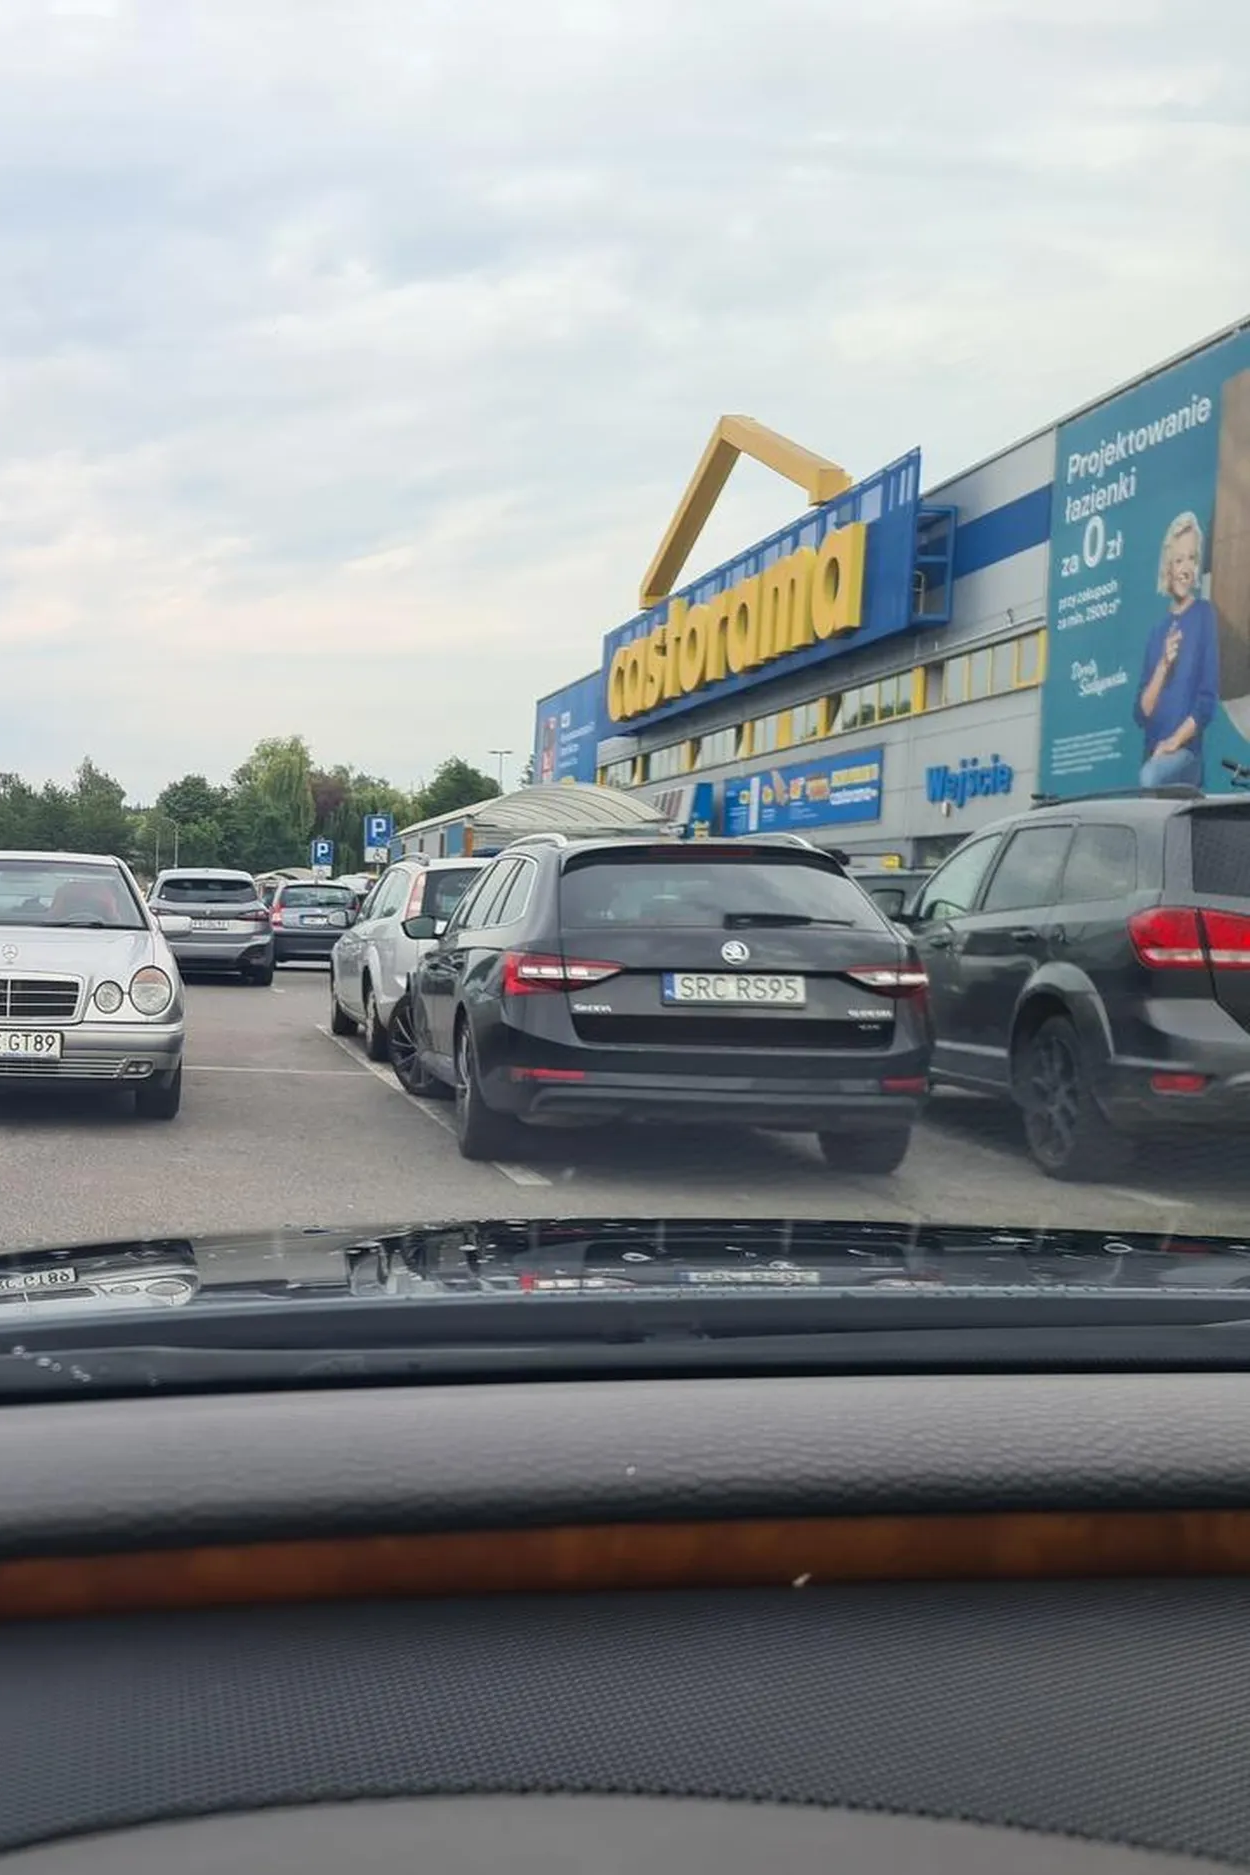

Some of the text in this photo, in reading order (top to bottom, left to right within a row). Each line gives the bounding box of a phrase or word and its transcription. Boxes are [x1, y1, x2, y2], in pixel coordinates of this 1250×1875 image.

[1067, 394, 1212, 484] Projektowanie
[1065, 465, 1137, 524] łazienki
[1061, 515, 1123, 577] za 0 zł
[607, 521, 869, 723] castorama
[371, 818, 387, 839] P
[317, 842, 330, 857] P
[680, 976, 798, 1000] SRC RS95
[8, 1034, 56, 1053] GT89
